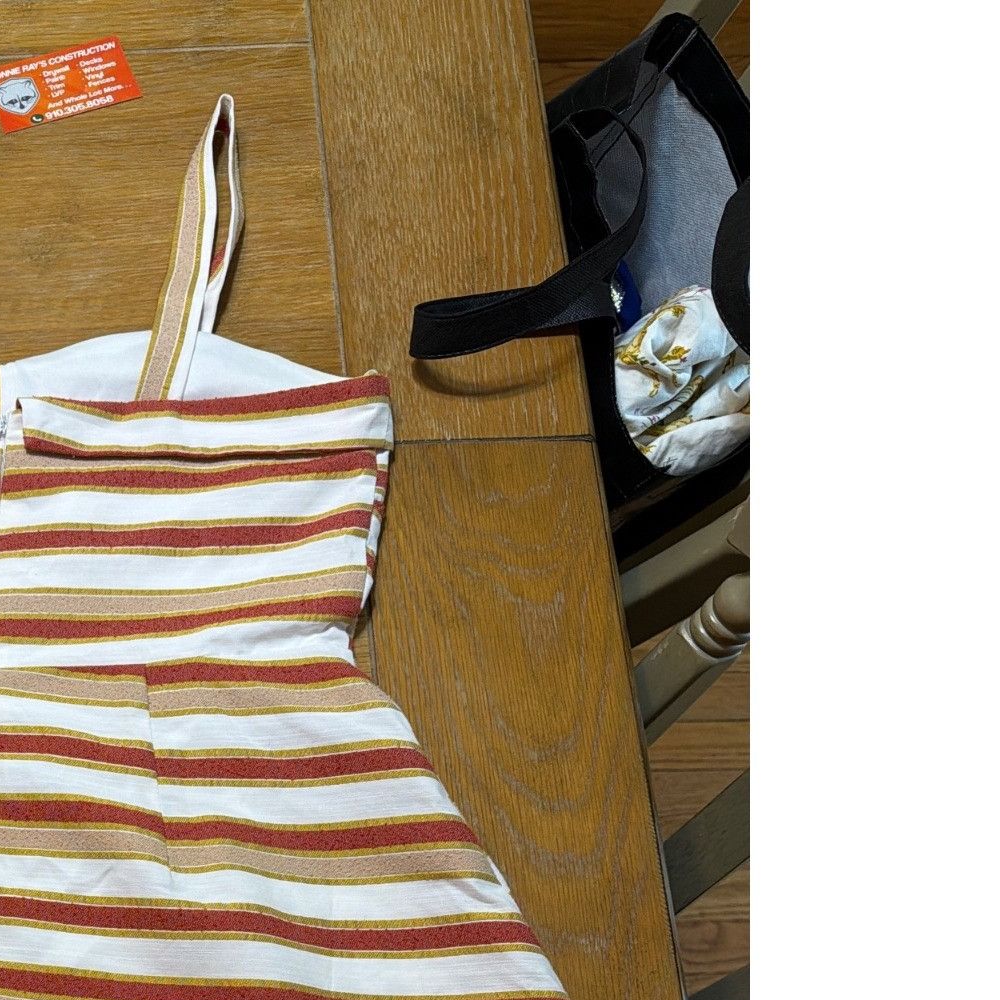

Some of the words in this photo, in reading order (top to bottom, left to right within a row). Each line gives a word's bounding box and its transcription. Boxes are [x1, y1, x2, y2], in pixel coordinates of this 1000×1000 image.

[22, 60, 47, 74] RAY'S
[48, 42, 115, 66] CONSTRUCTION
[79, 57, 104, 67] Decks
[43, 65, 70, 78] Drywall
[82, 61, 116, 74] Windows
[85, 71, 104, 81] Vinyl
[49, 82, 65, 91] Trim
[88, 77, 115, 88] Fences
[48, 99, 63, 109] And
[65, 94, 88, 105] Whole
